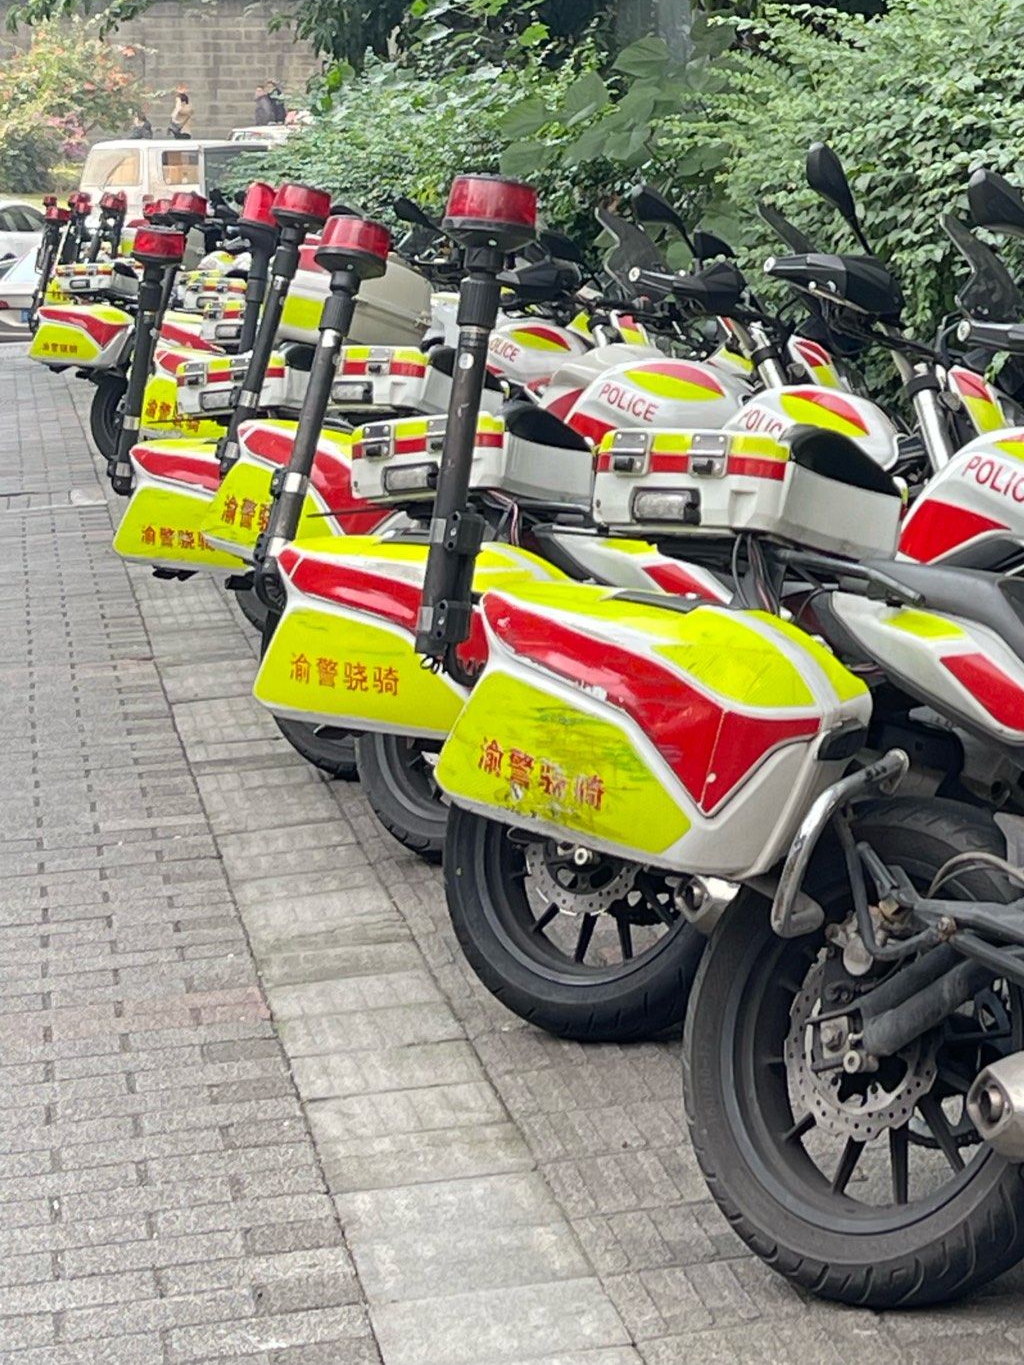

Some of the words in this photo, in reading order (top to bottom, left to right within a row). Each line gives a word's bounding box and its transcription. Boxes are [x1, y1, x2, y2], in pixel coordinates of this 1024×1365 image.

[489, 337, 521, 363] OLICE
[598, 383, 660, 423] POLICE
[737, 409, 784, 436] POLI
[222, 494, 271, 533] 渝警骁
[289, 652, 400, 697] 渝警骁骑
